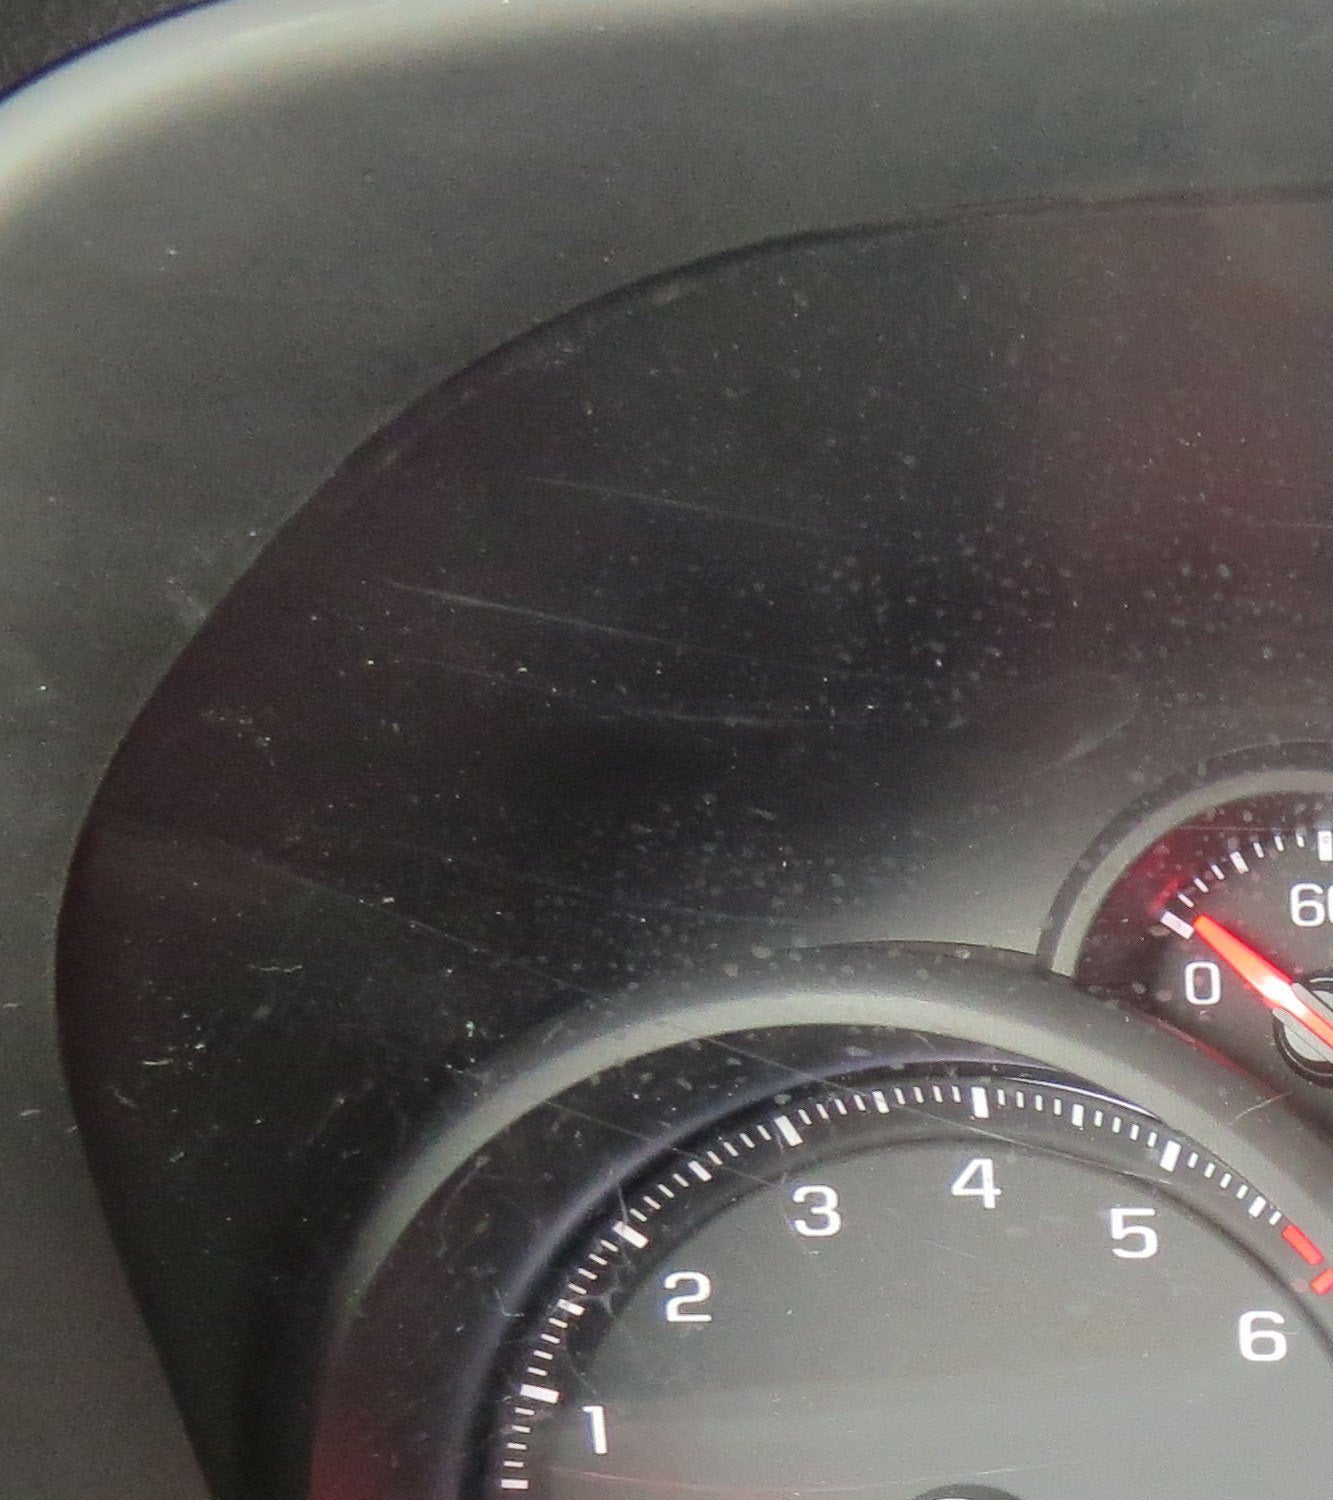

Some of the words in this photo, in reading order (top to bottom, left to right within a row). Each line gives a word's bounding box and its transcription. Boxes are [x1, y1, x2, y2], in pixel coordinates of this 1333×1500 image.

[1184, 960, 1221, 1005] 0
[950, 1158, 1002, 1209] 4
[792, 1185, 842, 1237] 3
[1109, 1207, 1158, 1259] 5
[664, 1271, 712, 1322] 2
[1238, 1310, 1287, 1362] 6
[582, 1405, 608, 1455] 1
